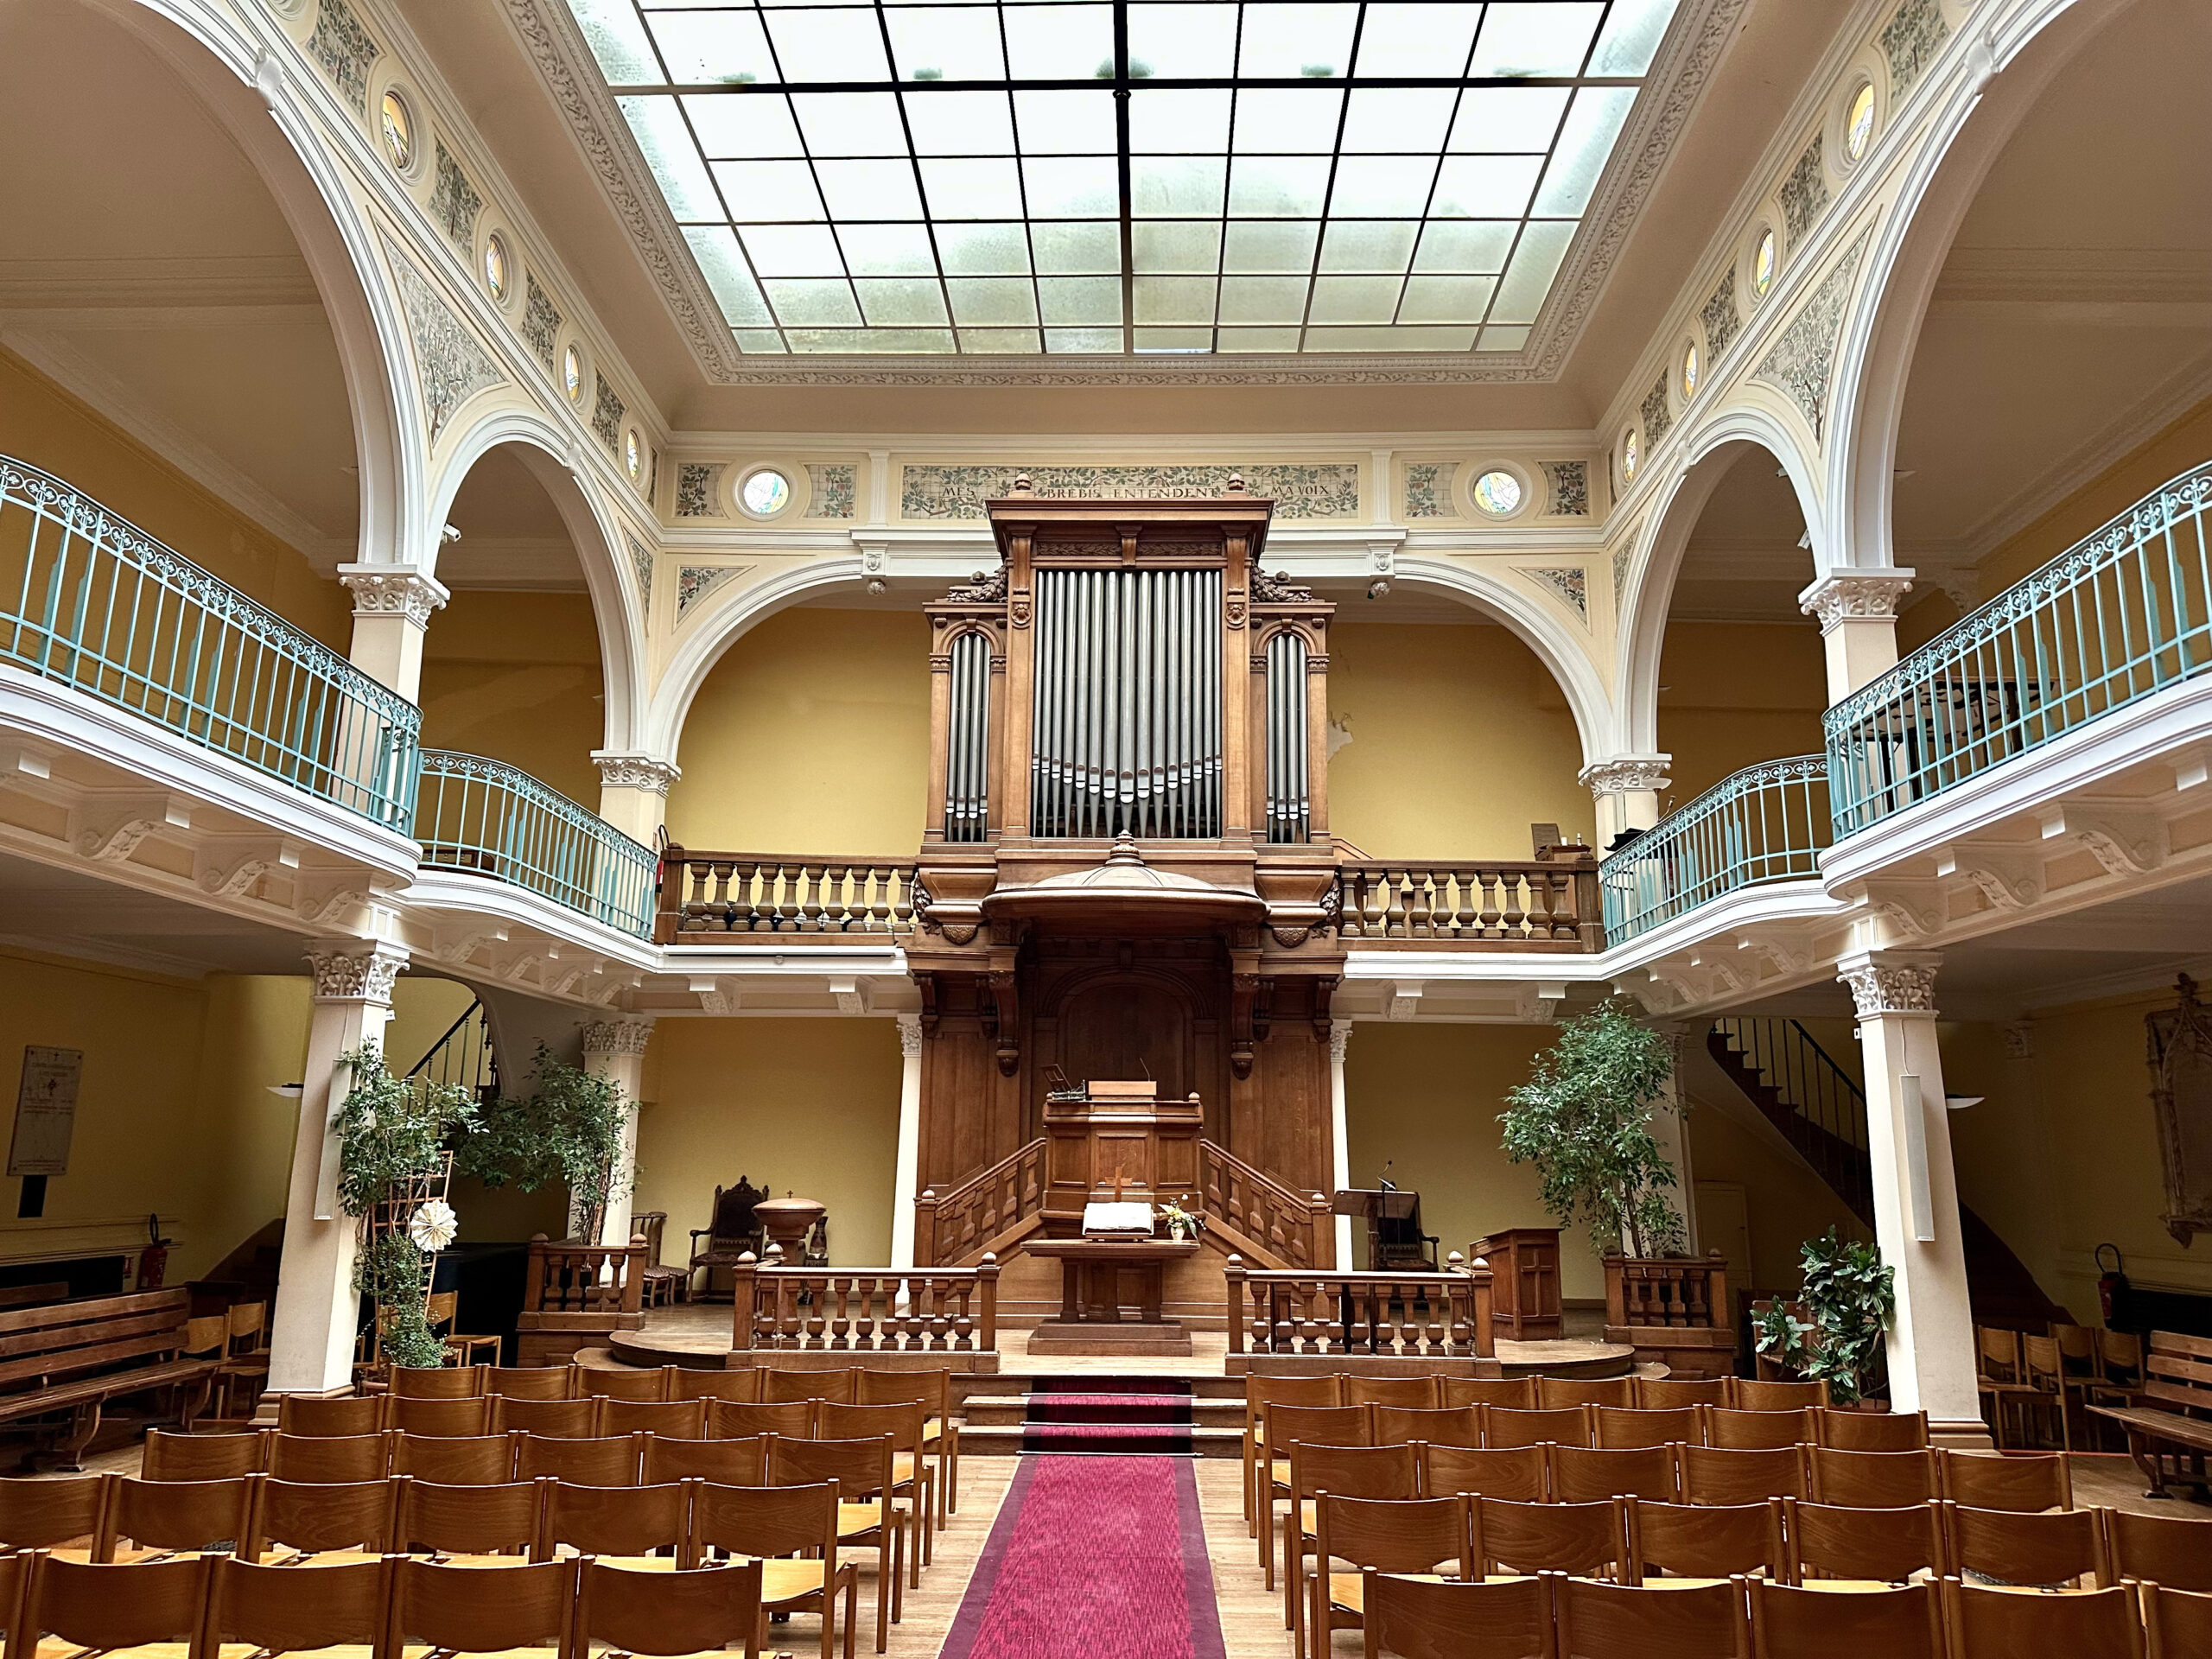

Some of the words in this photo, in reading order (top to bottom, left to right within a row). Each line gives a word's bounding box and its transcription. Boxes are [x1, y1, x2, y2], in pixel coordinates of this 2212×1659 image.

[942, 486, 975, 497] MES
[1047, 488, 1101, 499] BREBIS
[1114, 488, 1217, 499] ENTENDENT
[1270, 486, 1294, 495] MA
[1298, 486, 1329, 495] VOIX
